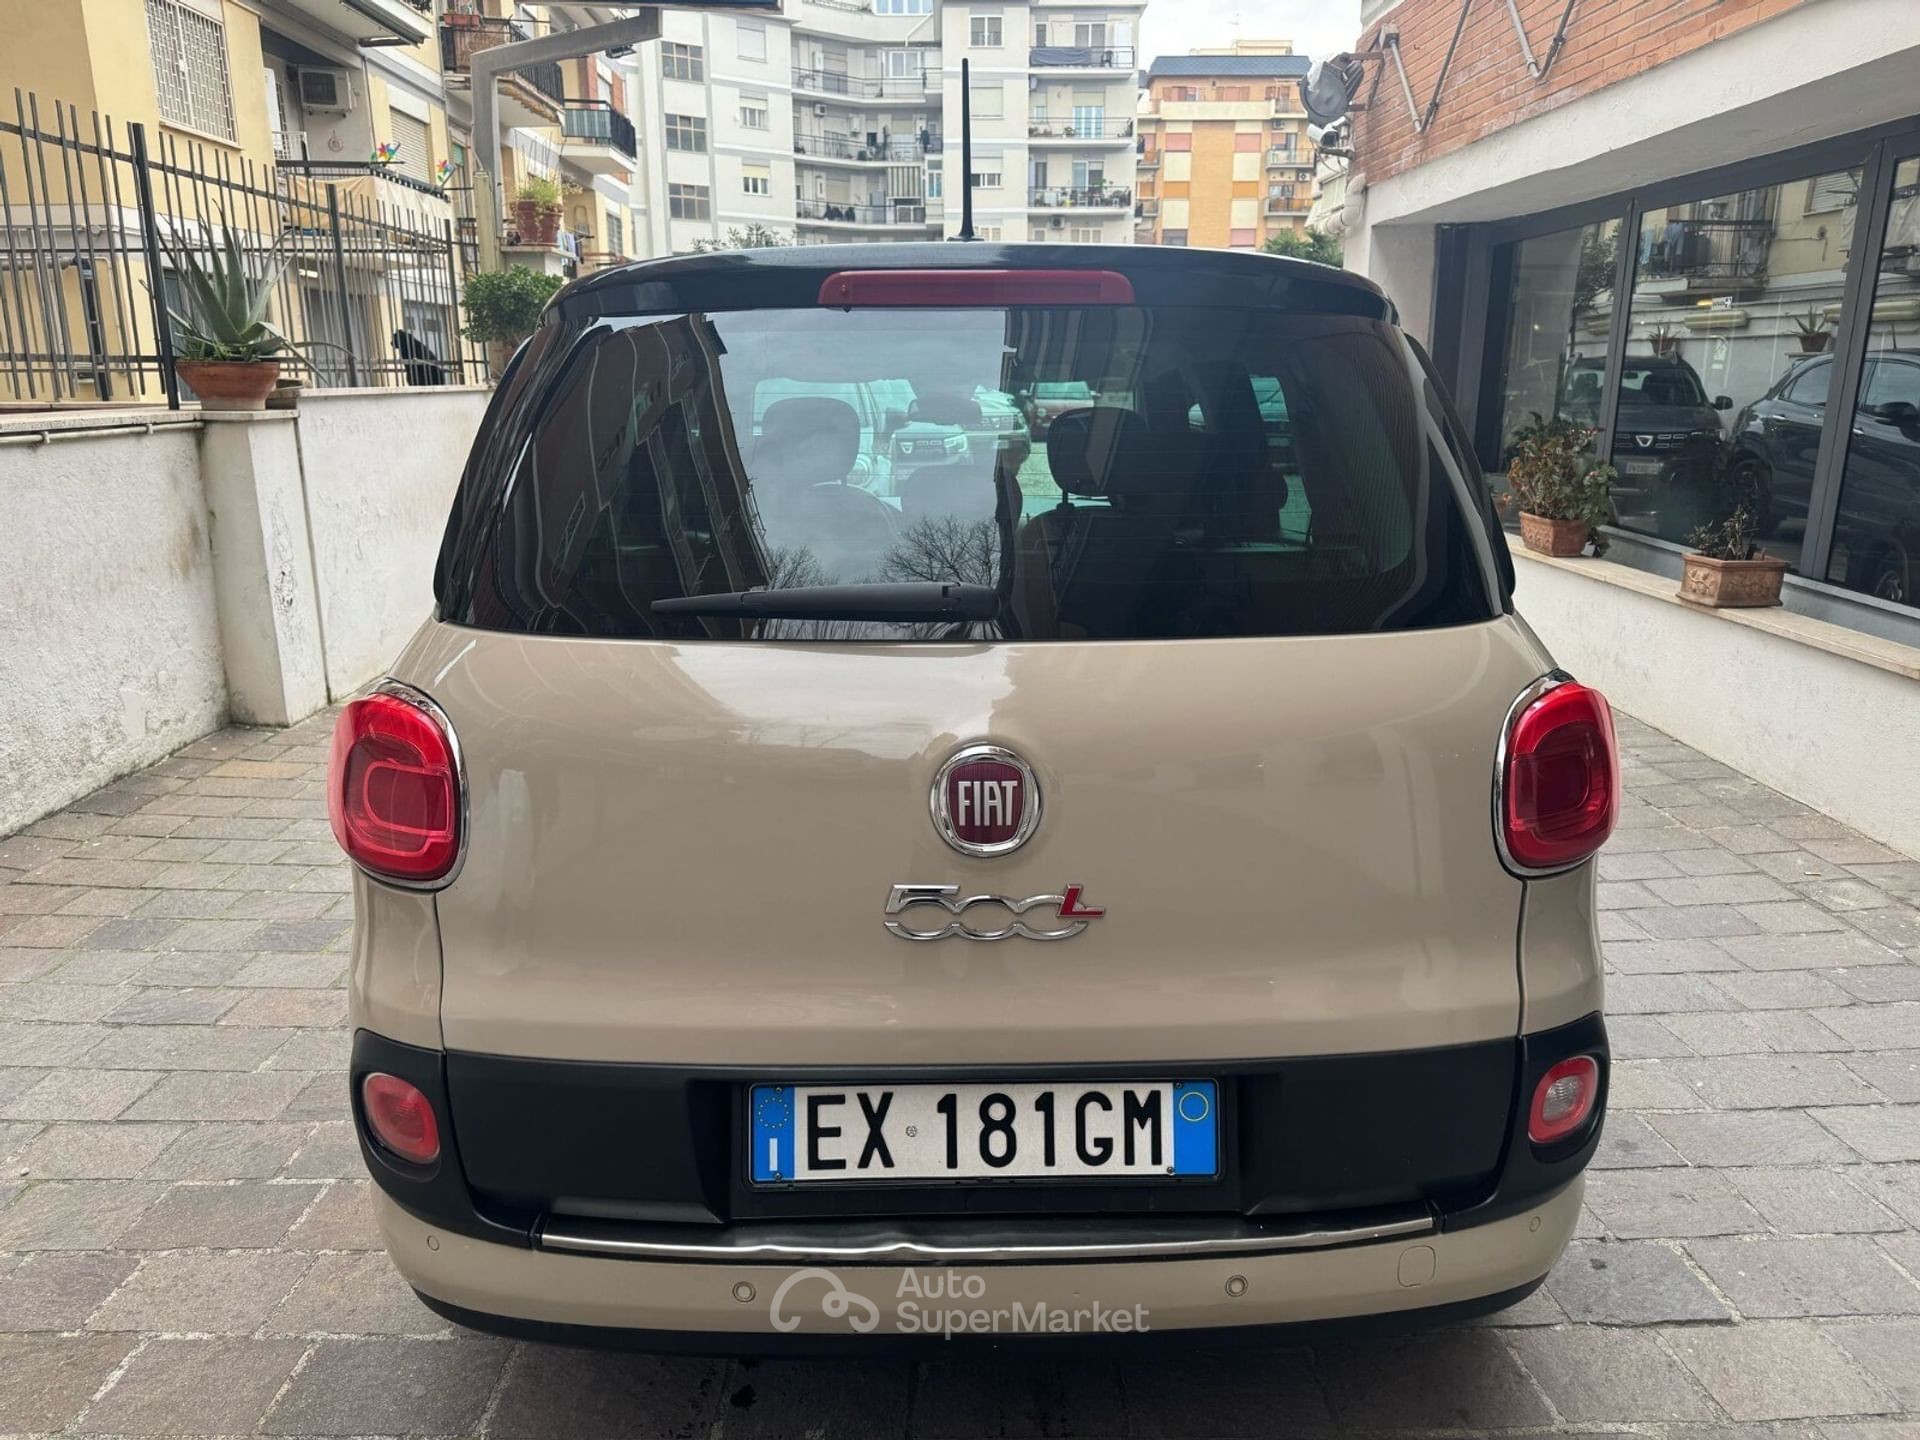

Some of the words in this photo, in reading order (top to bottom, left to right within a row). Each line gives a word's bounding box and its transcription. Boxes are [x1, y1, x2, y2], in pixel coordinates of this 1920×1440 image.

[957, 780, 1018, 827] FIAT
[884, 884, 1106, 941] 500L
[769, 1137, 778, 1171] I
[807, 1091, 894, 1170] EX
[937, 1089, 1163, 1169] 181GM
